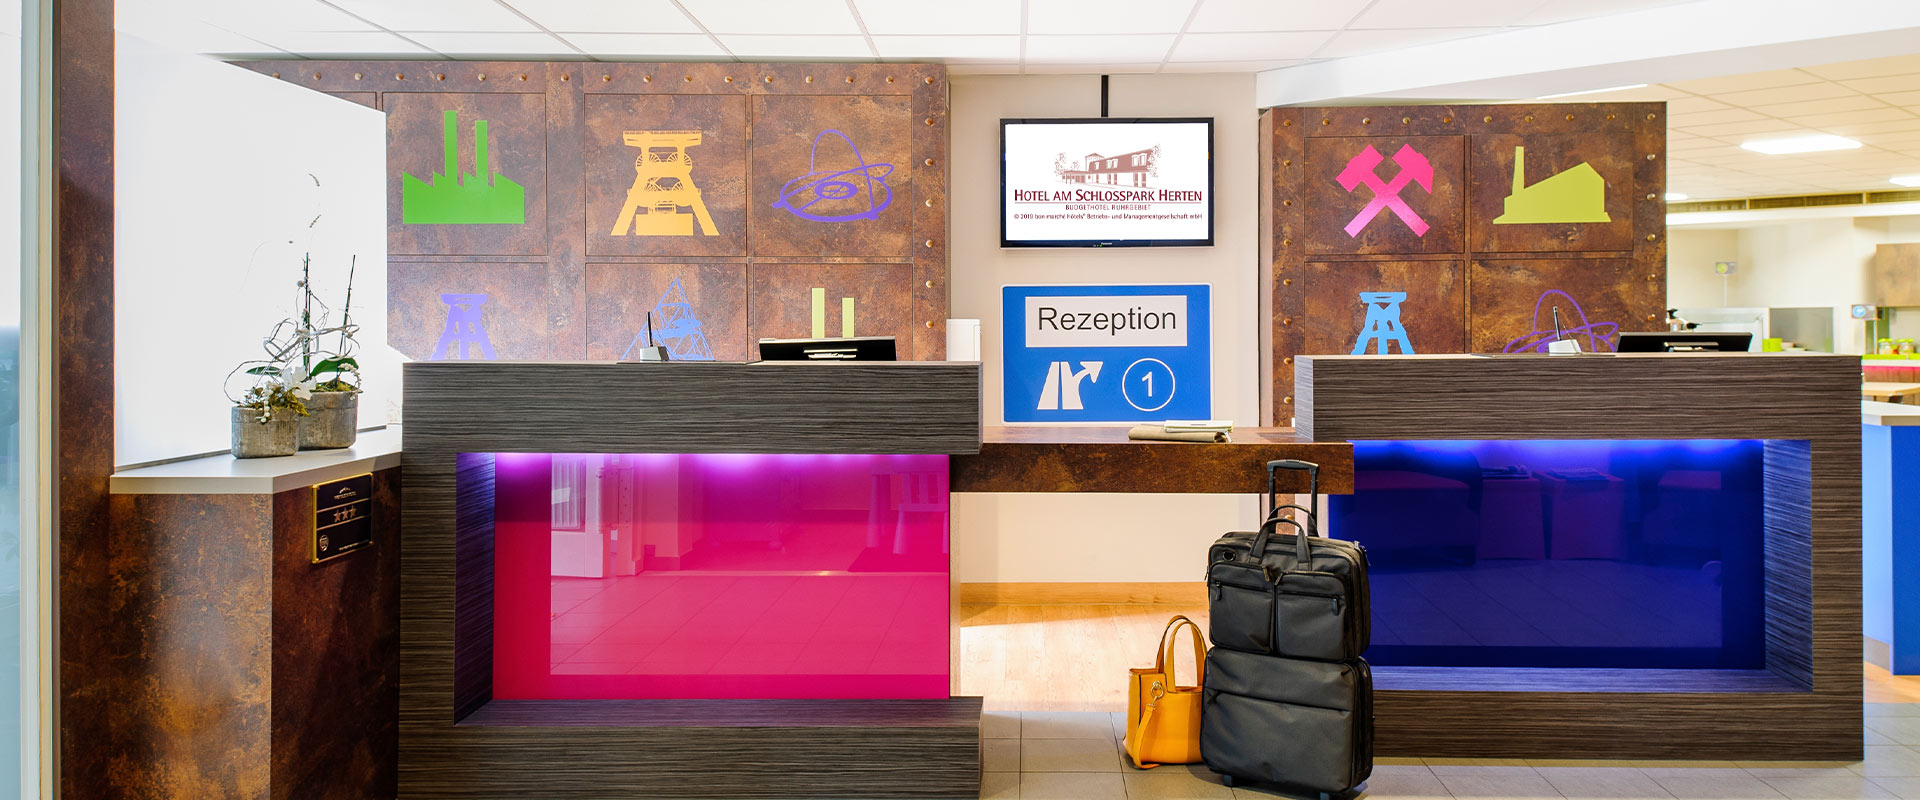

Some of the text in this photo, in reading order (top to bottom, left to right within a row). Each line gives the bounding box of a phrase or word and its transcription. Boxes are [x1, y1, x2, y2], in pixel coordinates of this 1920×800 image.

[1014, 189, 1202, 201] HOTEL AM SCHLOSSPARK HERTEN
[1123, 213, 1188, 221] Managementgesellschaft
[1038, 306, 1176, 336] Rezeption
[1141, 371, 1153, 397] 1
